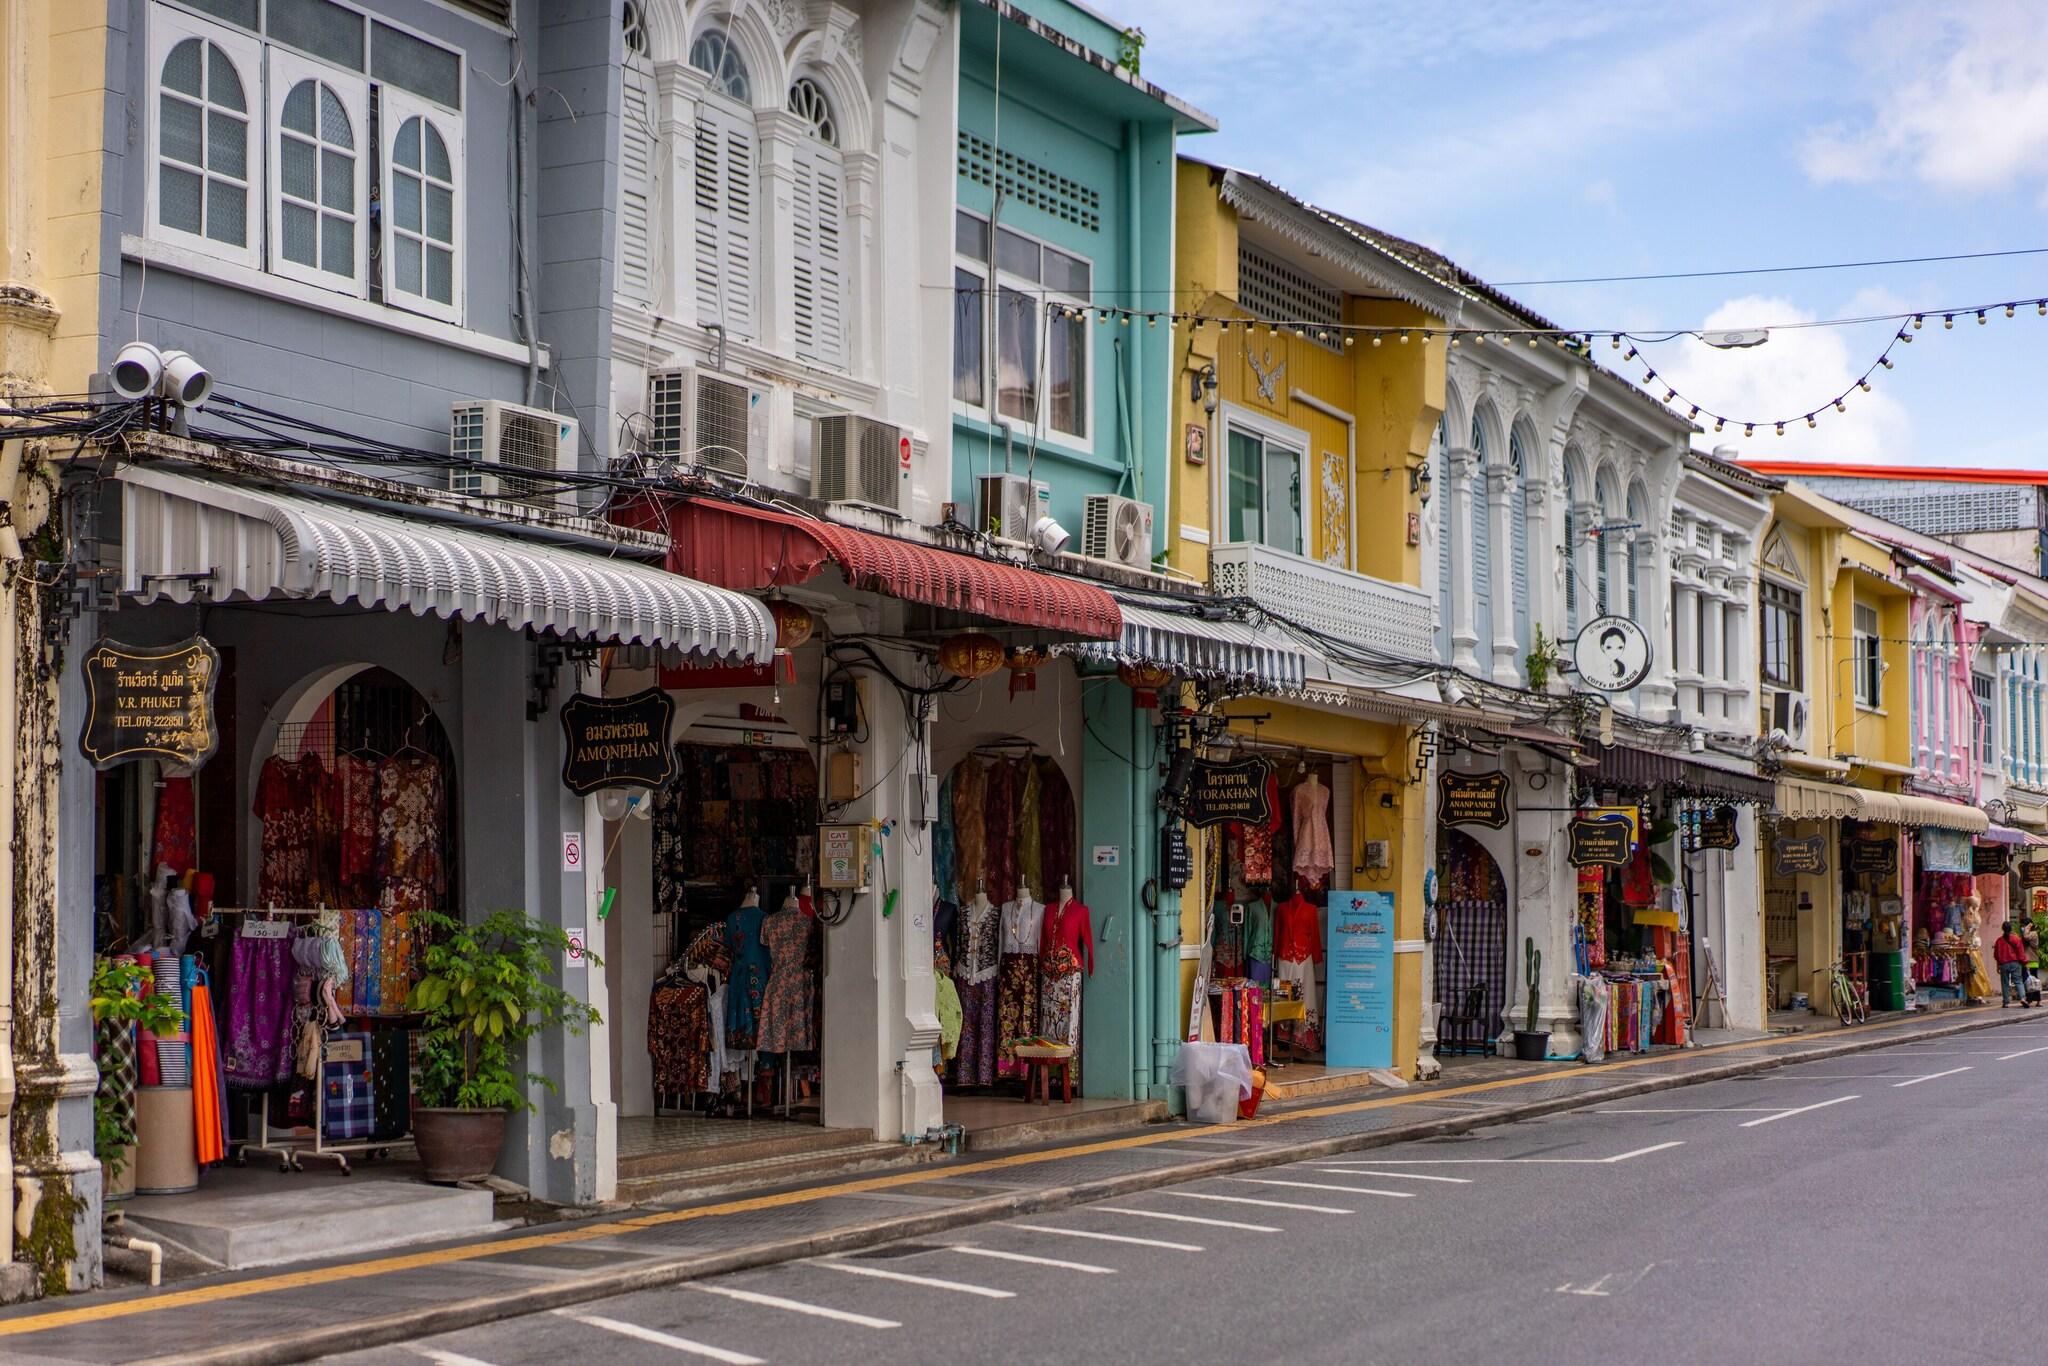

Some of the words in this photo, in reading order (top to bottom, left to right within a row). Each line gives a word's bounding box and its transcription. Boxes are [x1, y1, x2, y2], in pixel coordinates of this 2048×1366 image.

[102, 656, 117, 668] 102
[118, 670, 158, 688] ร้านวีอาร์
[160, 669, 184, 691] ภูเก็ต
[118, 697, 138, 708] V.R.
[140, 696, 183, 708] PHUKET
[586, 722, 649, 741] อมรพรรณ
[577, 742, 659, 762] AMONPHAN
[1197, 787, 1258, 800] TORAKHAN
[1449, 801, 1496, 809] ANANPANICH
